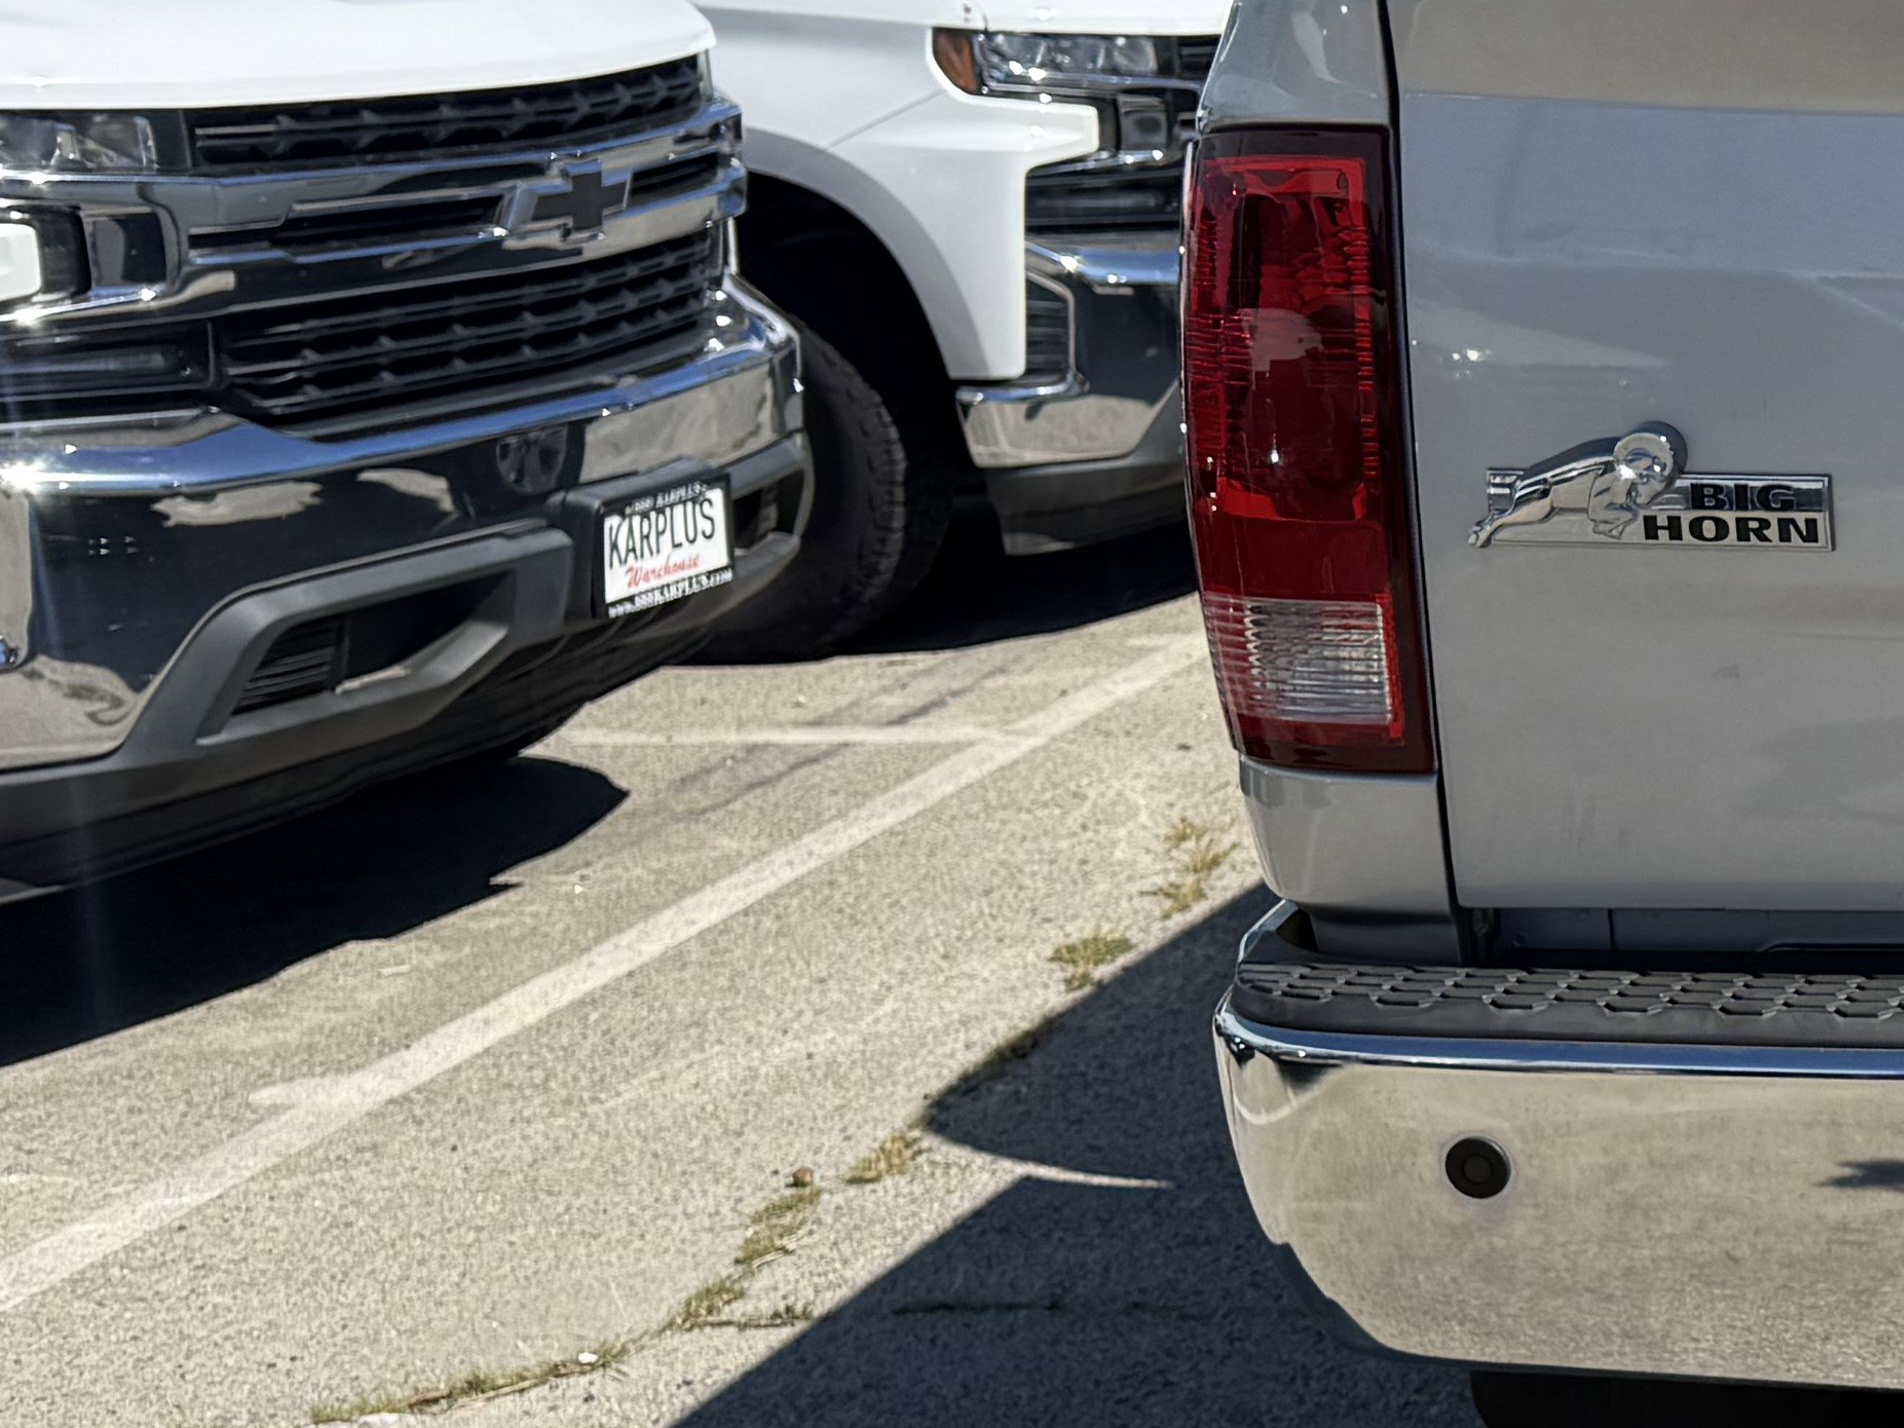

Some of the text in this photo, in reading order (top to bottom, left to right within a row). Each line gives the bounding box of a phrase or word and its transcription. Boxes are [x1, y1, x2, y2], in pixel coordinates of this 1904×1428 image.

[1689, 482, 1796, 513] BIG
[608, 497, 715, 570] KARPLUS
[1641, 514, 1819, 544] HORN
[625, 553, 700, 589] Warehouse
